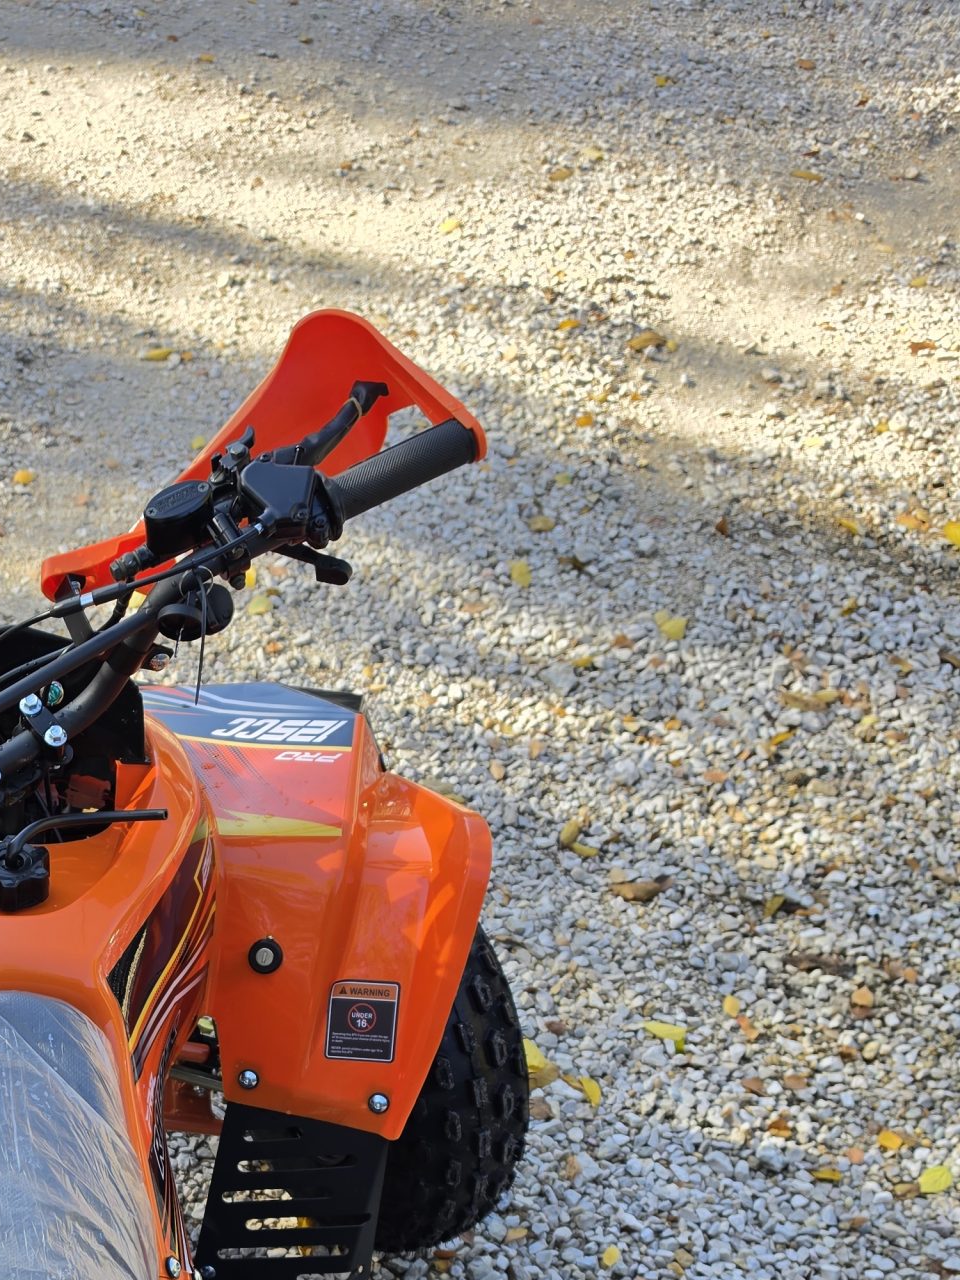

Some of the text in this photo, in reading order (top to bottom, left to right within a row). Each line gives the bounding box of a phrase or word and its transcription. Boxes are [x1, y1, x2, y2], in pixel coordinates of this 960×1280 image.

[211, 717, 348, 743] 125CC
[274, 751, 343, 763] PRO
[350, 988, 390, 997] WARNING
[356, 1020, 367, 1028] 16
